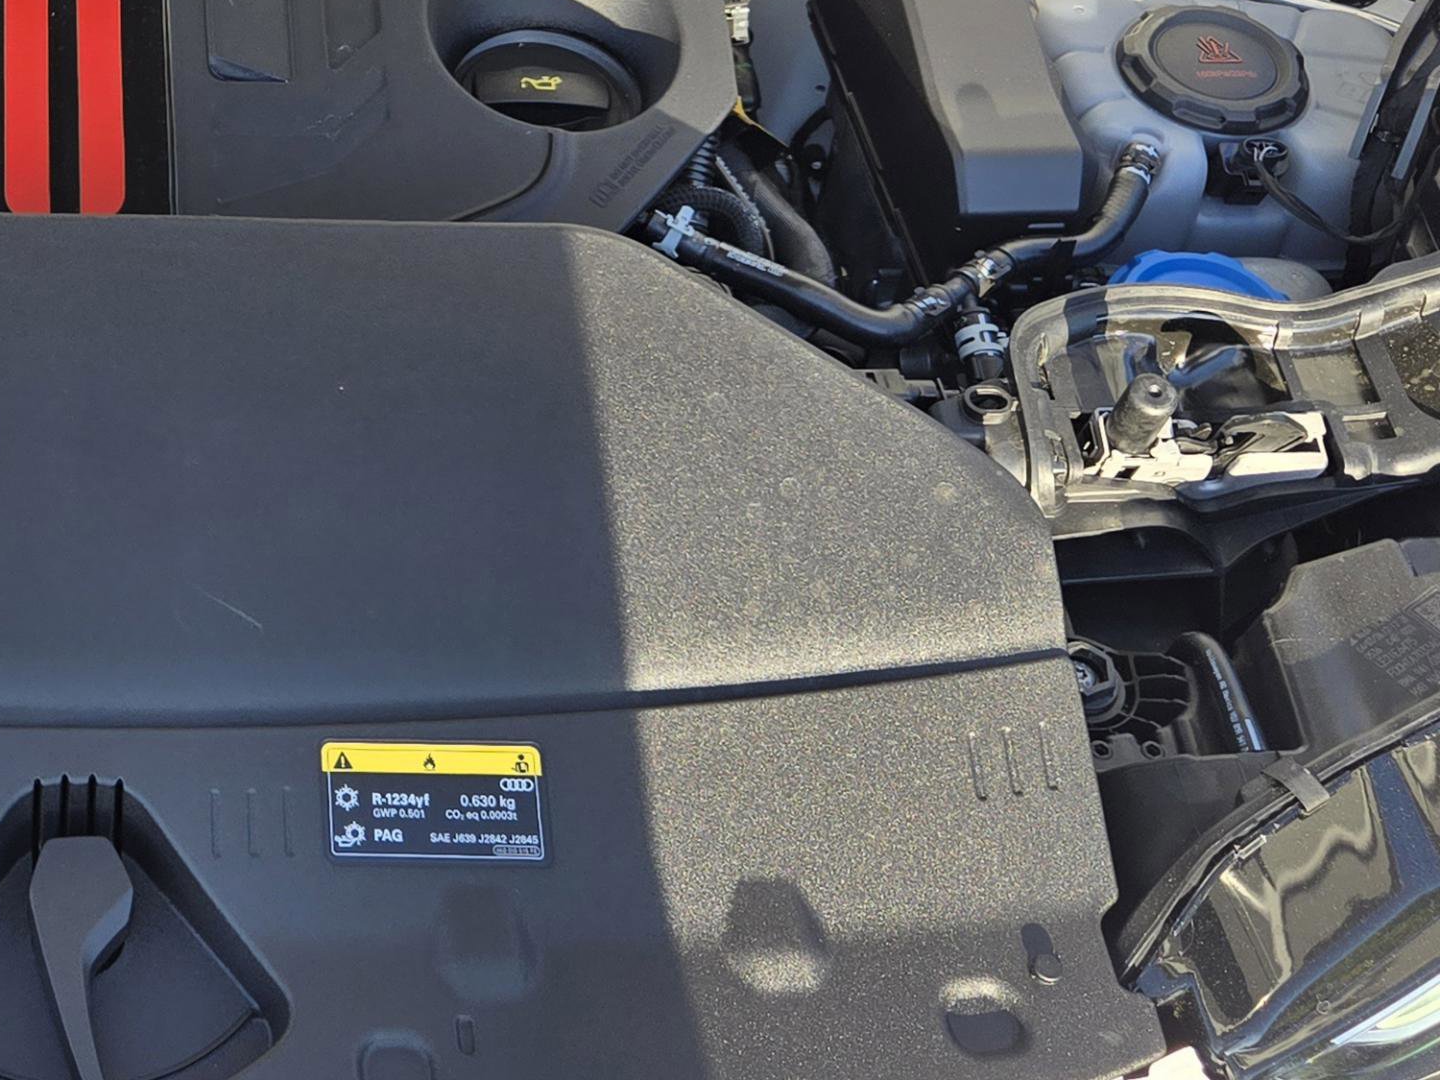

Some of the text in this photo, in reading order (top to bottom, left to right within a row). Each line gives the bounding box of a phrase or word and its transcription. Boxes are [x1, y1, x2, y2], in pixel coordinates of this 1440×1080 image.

[372, 793, 430, 808] R-1234yf
[460, 795, 516, 810] 0.630 kg
[373, 808, 426, 819] GWP 0.501
[466, 811, 480, 822] eq
[374, 830, 404, 843] PAG
[430, 832, 539, 845] SAE J639 J2842 J2845
